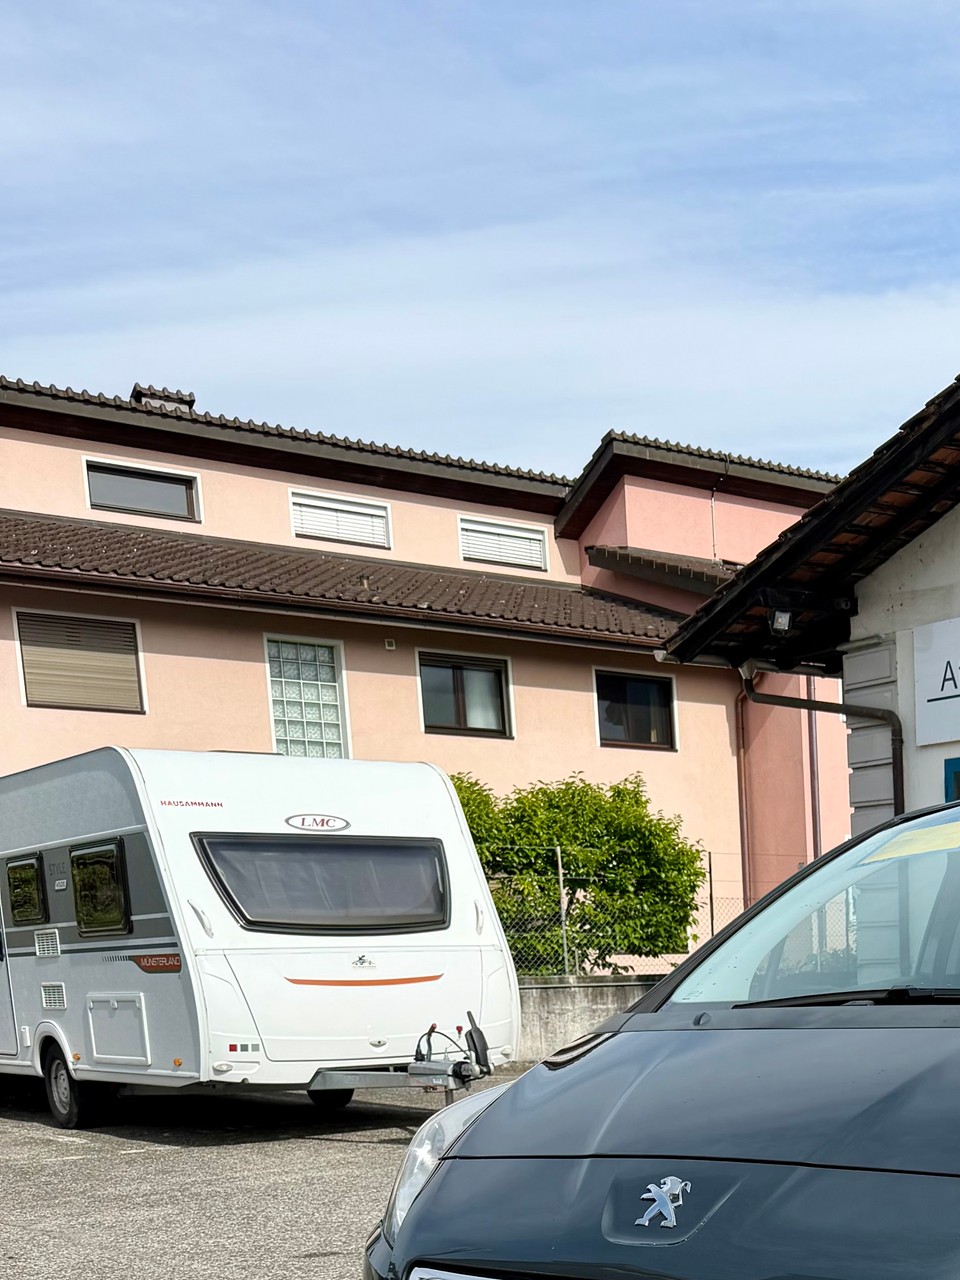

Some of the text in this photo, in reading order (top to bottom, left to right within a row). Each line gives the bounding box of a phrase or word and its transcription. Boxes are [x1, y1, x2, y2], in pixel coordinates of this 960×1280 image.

[160, 800, 223, 808] HAUSAMMANN
[301, 817, 336, 828] LMC
[141, 956, 180, 967] MÜNSTERLAND
